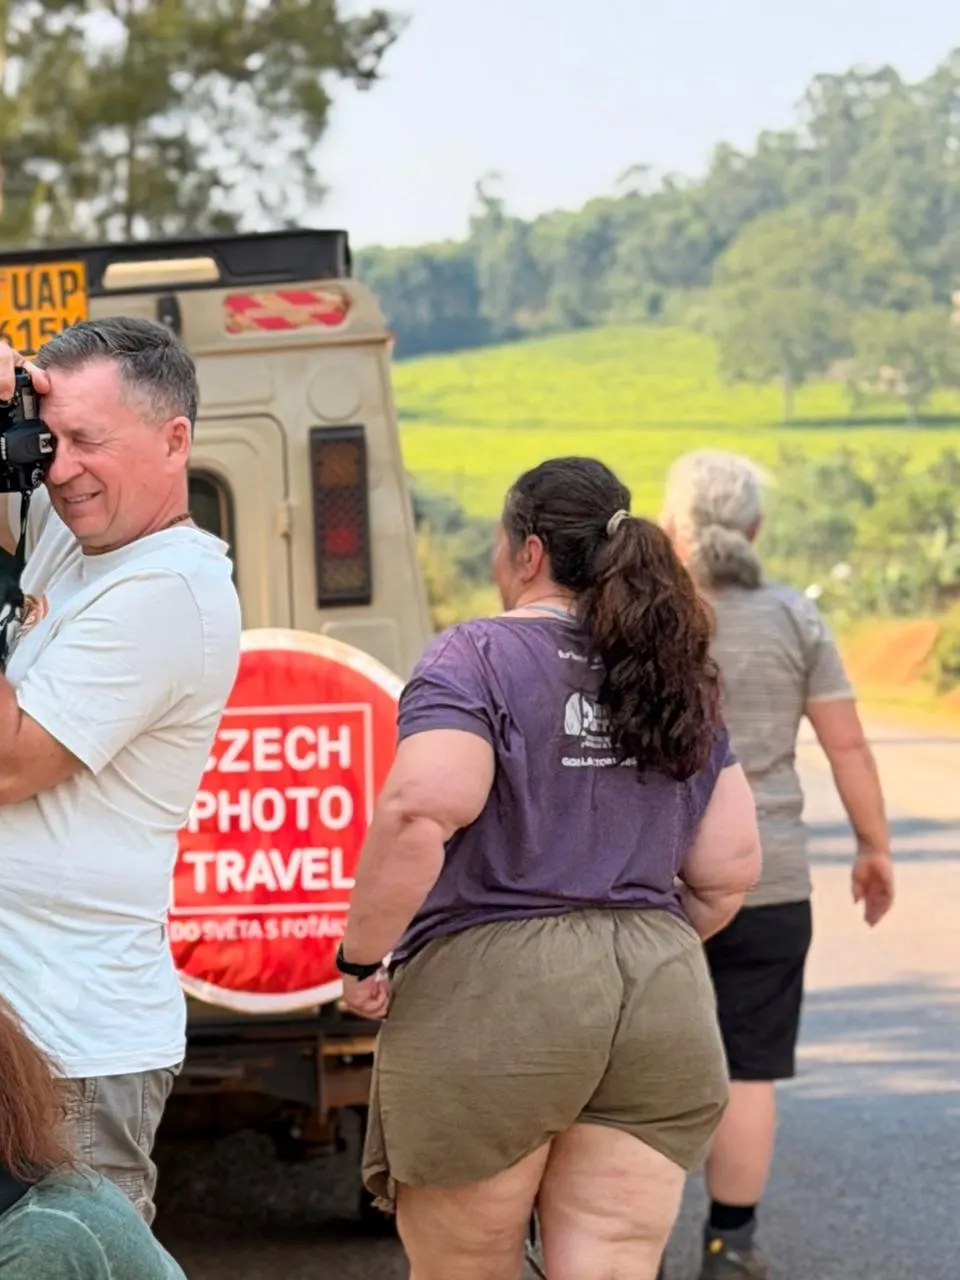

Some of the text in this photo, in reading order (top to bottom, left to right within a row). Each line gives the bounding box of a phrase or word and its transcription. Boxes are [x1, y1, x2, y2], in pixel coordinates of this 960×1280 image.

[11, 269, 78, 312] UAP
[204, 725, 352, 773] ZECH
[187, 786, 355, 834] PHOTO
[182, 847, 355, 894] TRAVEL
[169, 920, 201, 943] DO
[264, 918, 279, 941] S
